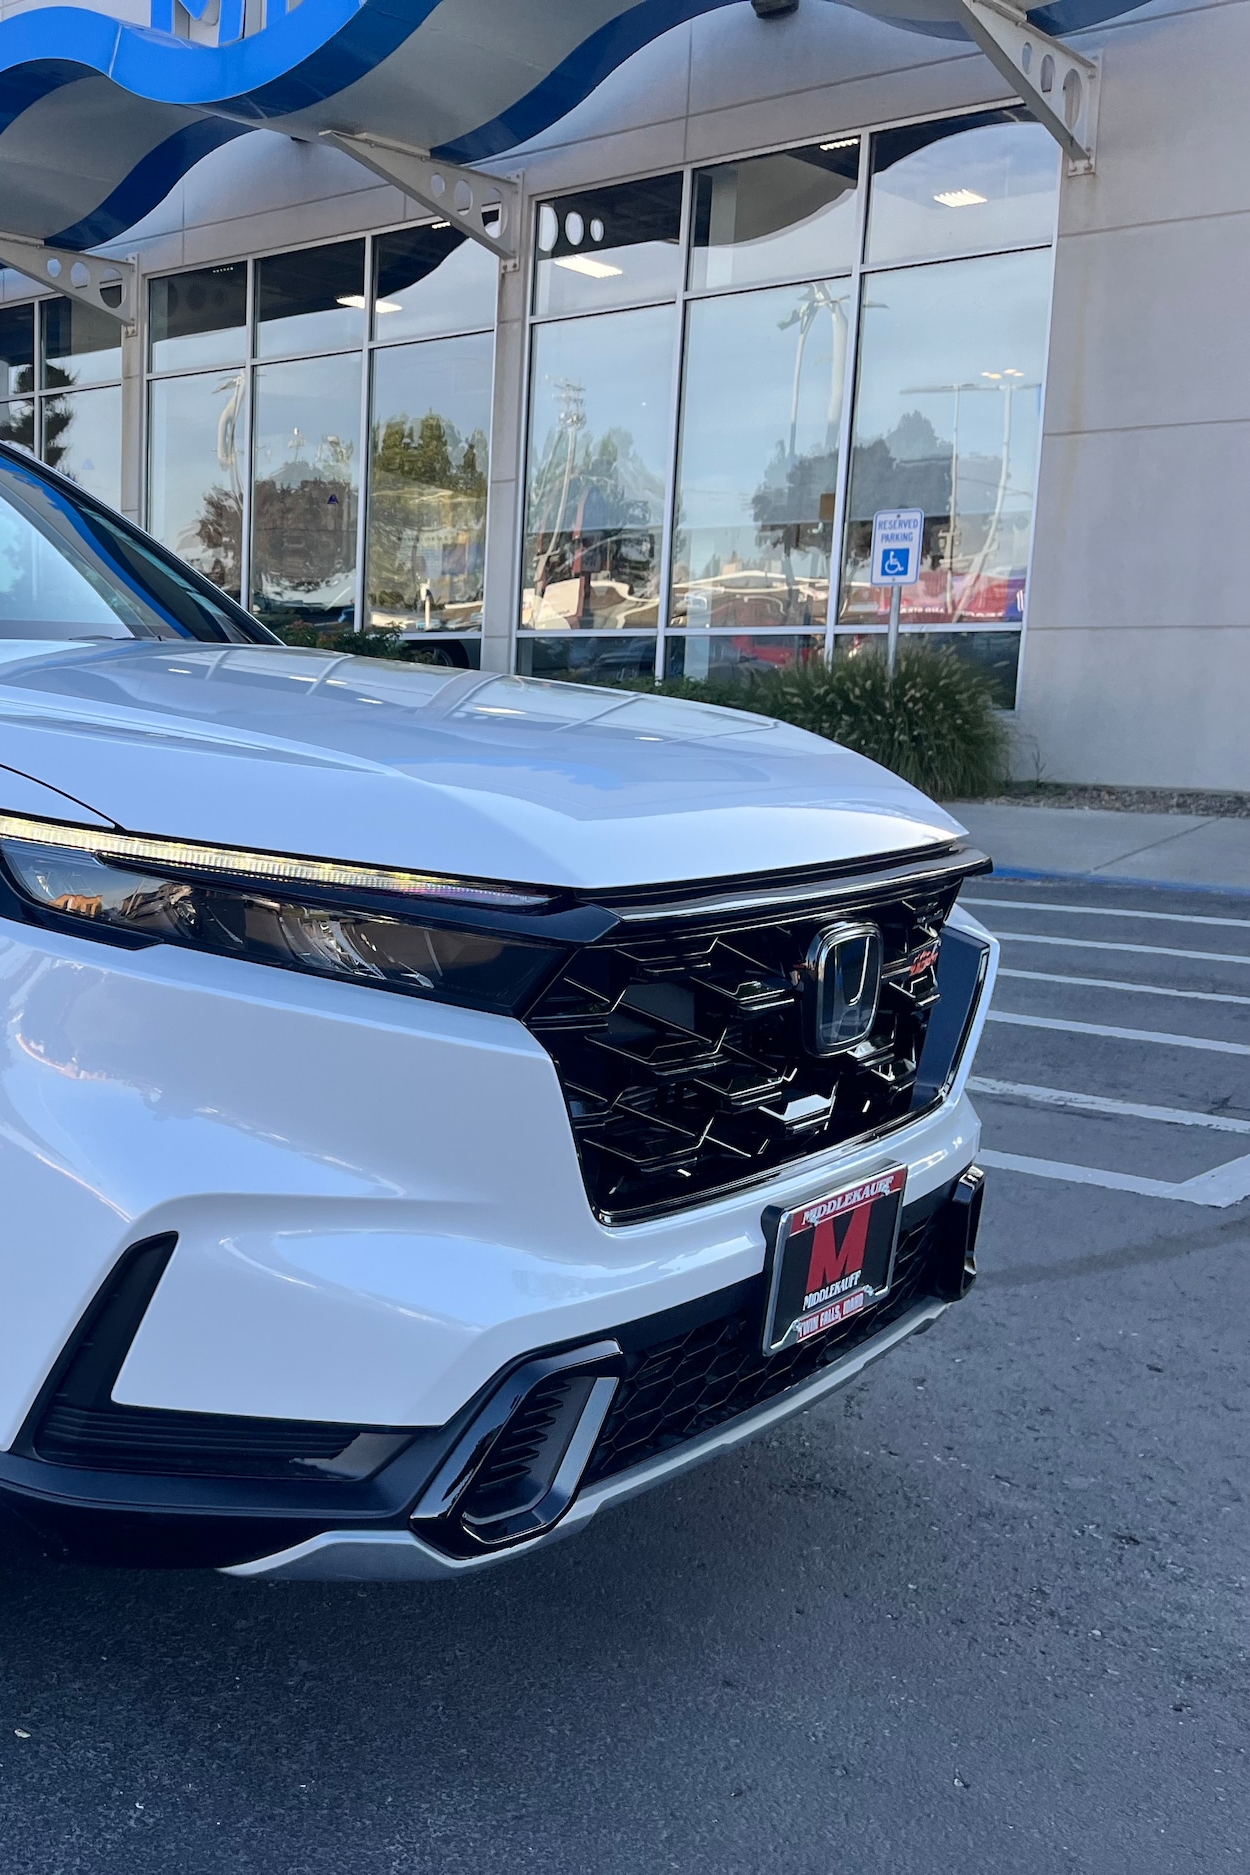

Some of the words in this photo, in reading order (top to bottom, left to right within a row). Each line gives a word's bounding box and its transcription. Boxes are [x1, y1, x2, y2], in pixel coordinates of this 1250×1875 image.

[878, 519, 919, 530] RESERVED
[881, 532, 914, 543] PARKING
[805, 1202, 872, 1294] M
[802, 1269, 862, 1312] MIDDLEKAUFF
[797, 1315, 819, 1338] TWIN
